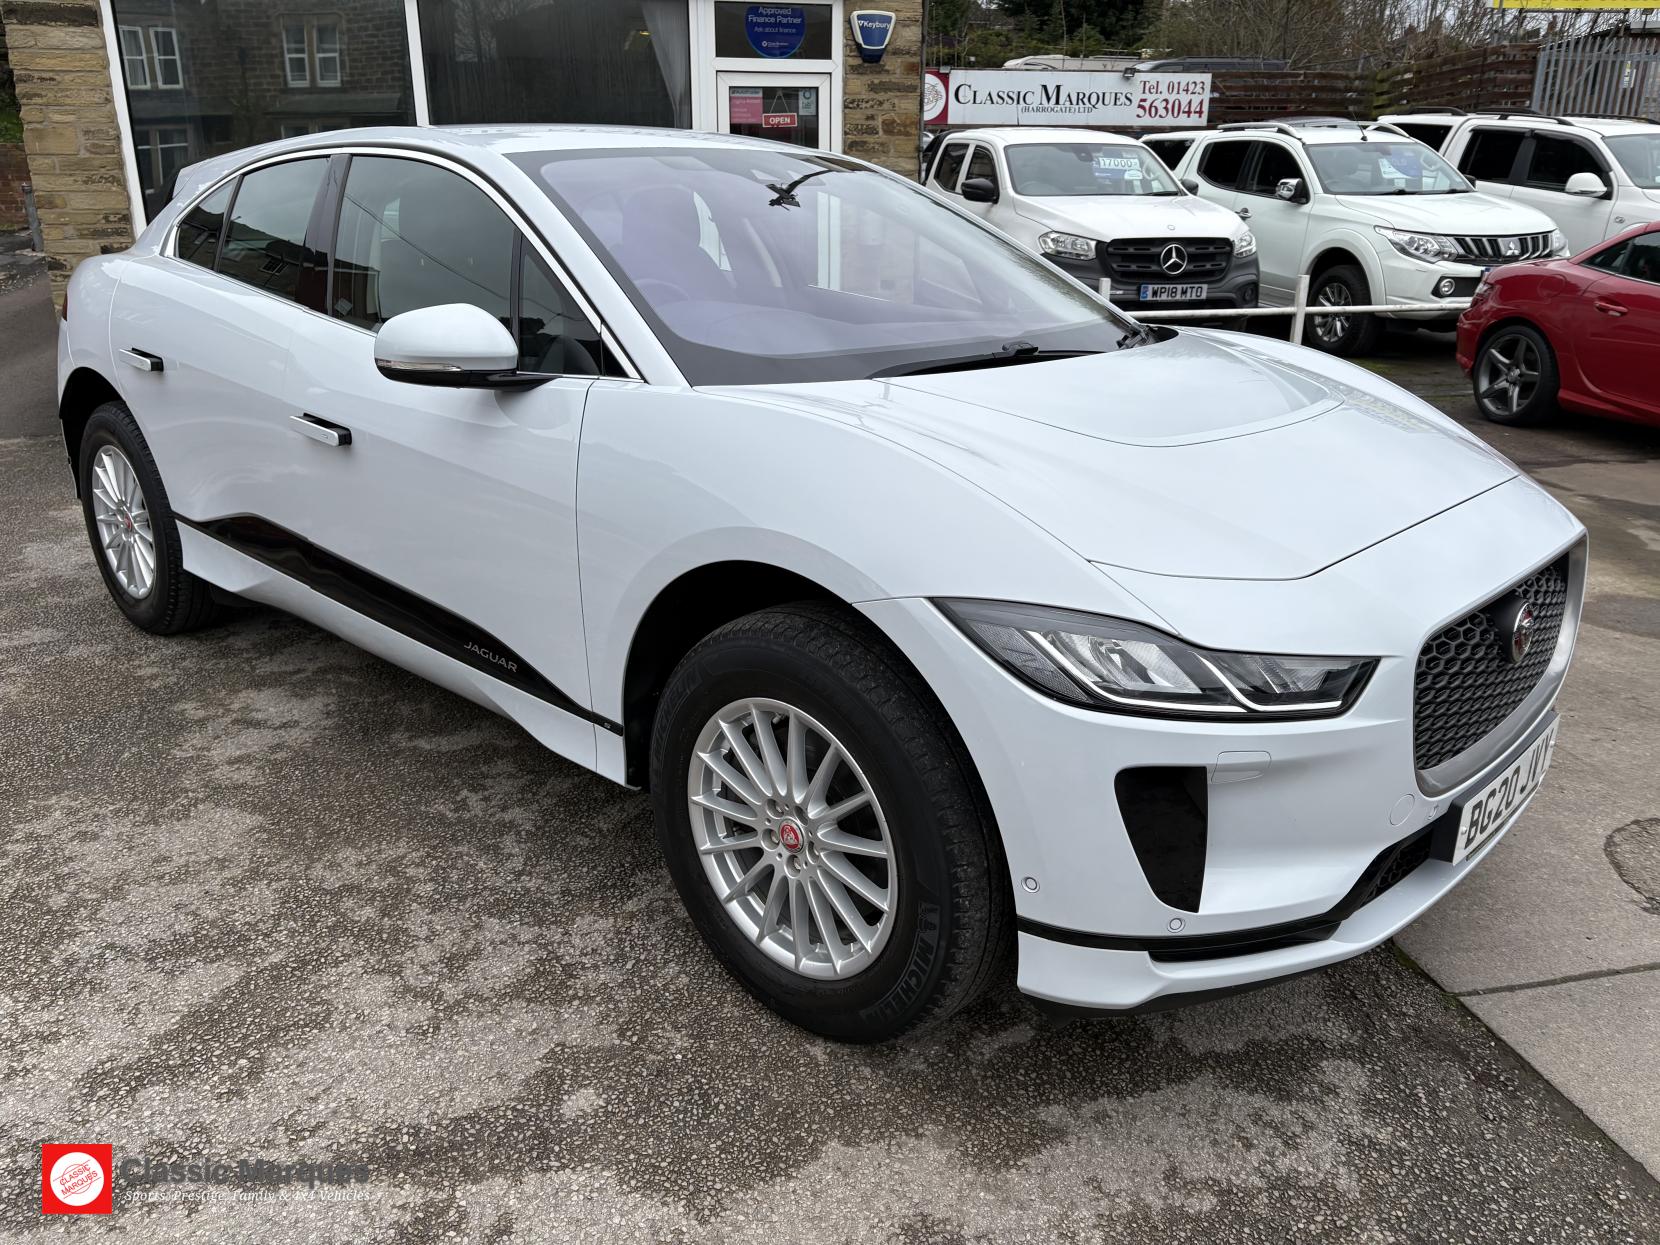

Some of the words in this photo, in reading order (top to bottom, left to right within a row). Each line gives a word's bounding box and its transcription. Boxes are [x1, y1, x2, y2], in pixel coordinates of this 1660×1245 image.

[758, 6, 792, 15] Approved
[748, 14, 776, 23] Finance
[776, 15, 802, 24] Partner
[863, 21, 891, 30] Keybury
[1139, 80, 1163, 95] Tel.
[1167, 80, 1206, 96] 01423
[954, 83, 1035, 105] CLASSIC
[1038, 84, 1133, 110] MARQUES
[1020, 105, 1077, 114] (HARROGATE)
[1077, 106, 1094, 114] LTD
[1135, 98, 1205, 119] 563044
[769, 117, 791, 125] OPEN
[1151, 286, 1178, 299] WP18
[1180, 286, 1203, 298] MTO
[463, 641, 518, 673] JAGUAR
[1464, 764, 1521, 850] BG20
